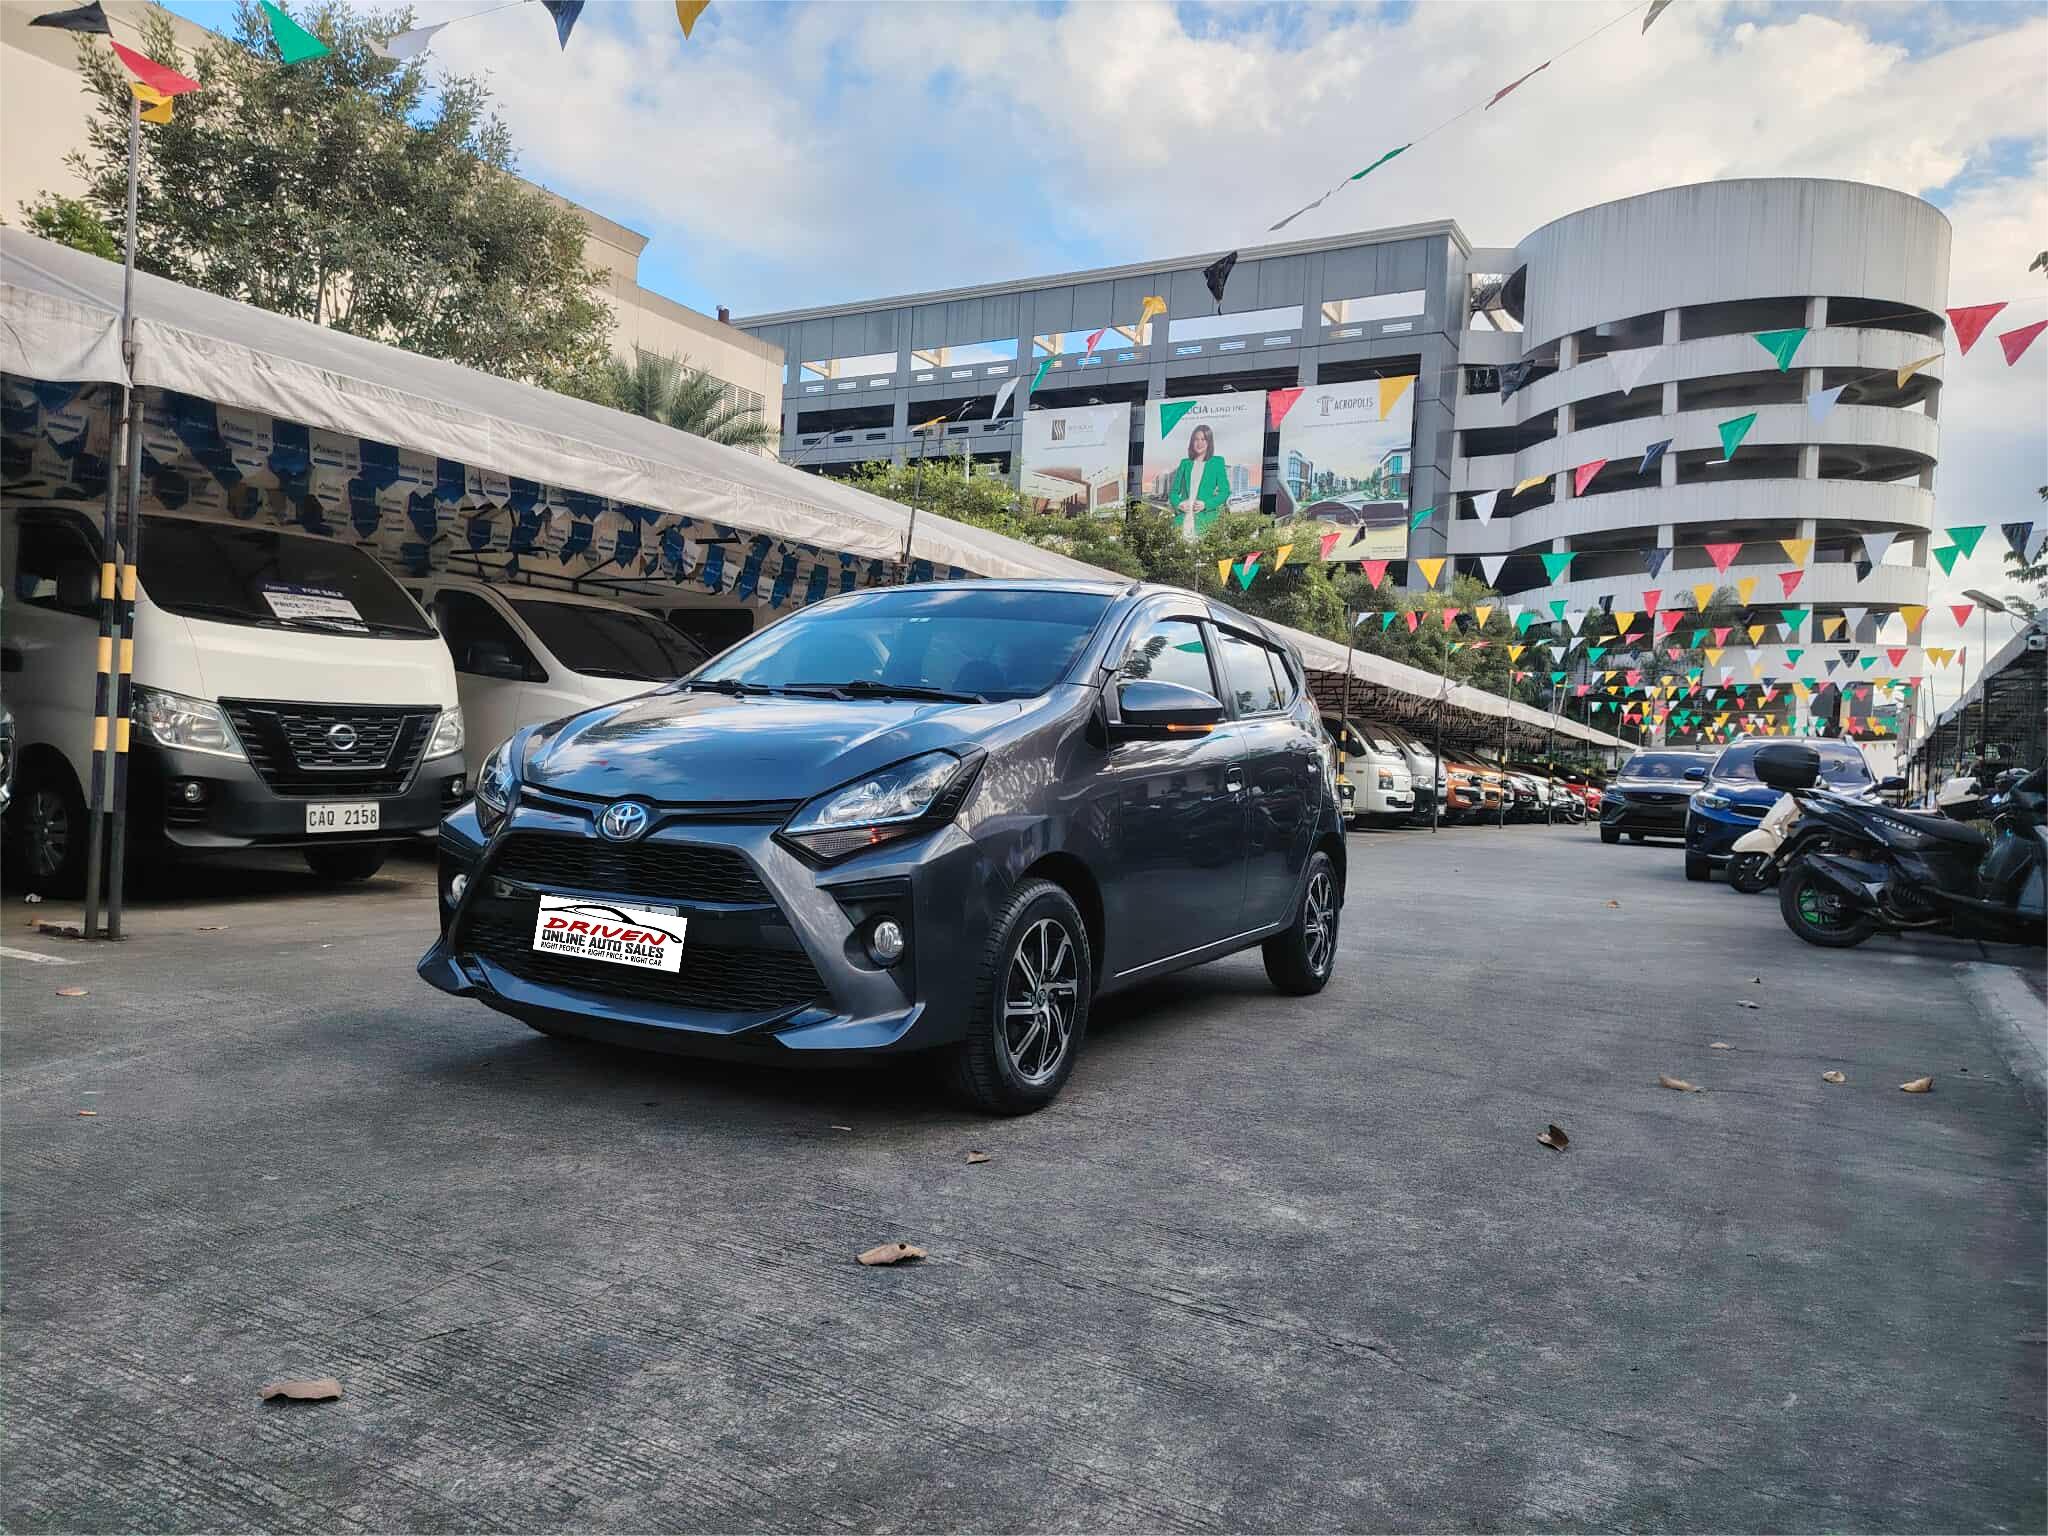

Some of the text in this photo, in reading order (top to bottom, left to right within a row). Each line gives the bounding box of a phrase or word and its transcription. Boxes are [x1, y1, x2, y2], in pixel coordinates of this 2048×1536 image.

[1334, 397, 1374, 410] ACROPOLIS
[309, 809, 377, 827] CAQ 2158
